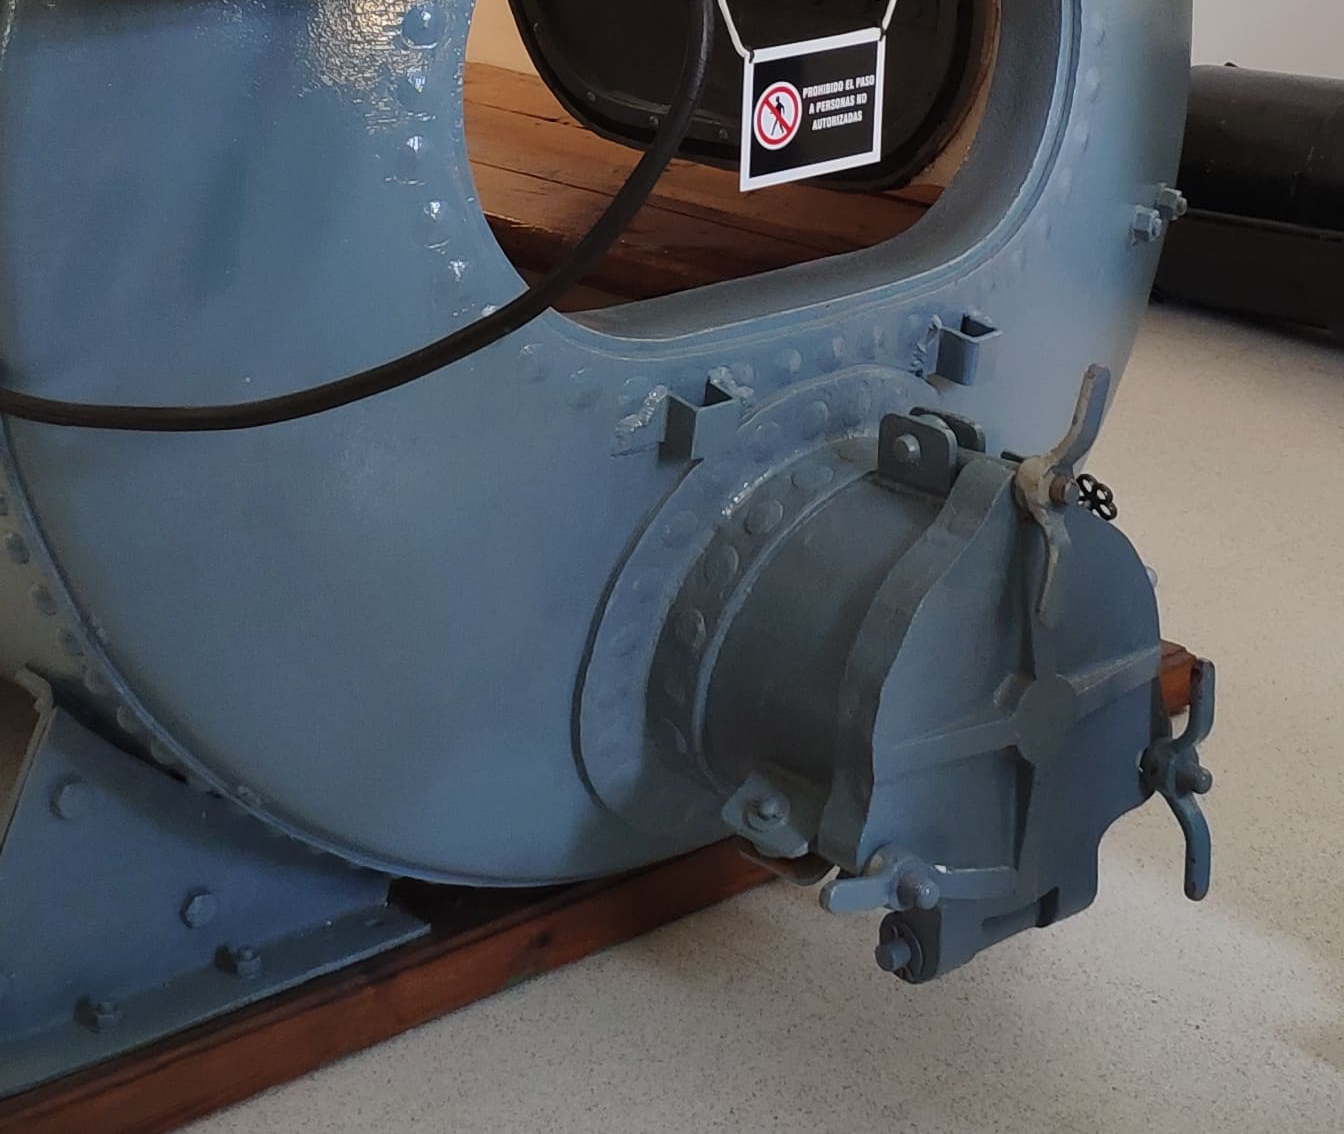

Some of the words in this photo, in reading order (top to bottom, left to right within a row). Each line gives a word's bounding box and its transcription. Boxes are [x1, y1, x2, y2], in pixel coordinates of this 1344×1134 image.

[802, 80, 844, 99] PROHIBIDO
[845, 79, 855, 91] EL
[855, 74, 875, 89] PASO
[808, 102, 815, 115] A
[816, 94, 856, 113] PERSONAS
[856, 92, 868, 105] NO
[811, 109, 863, 131] AUTORIZADAS
